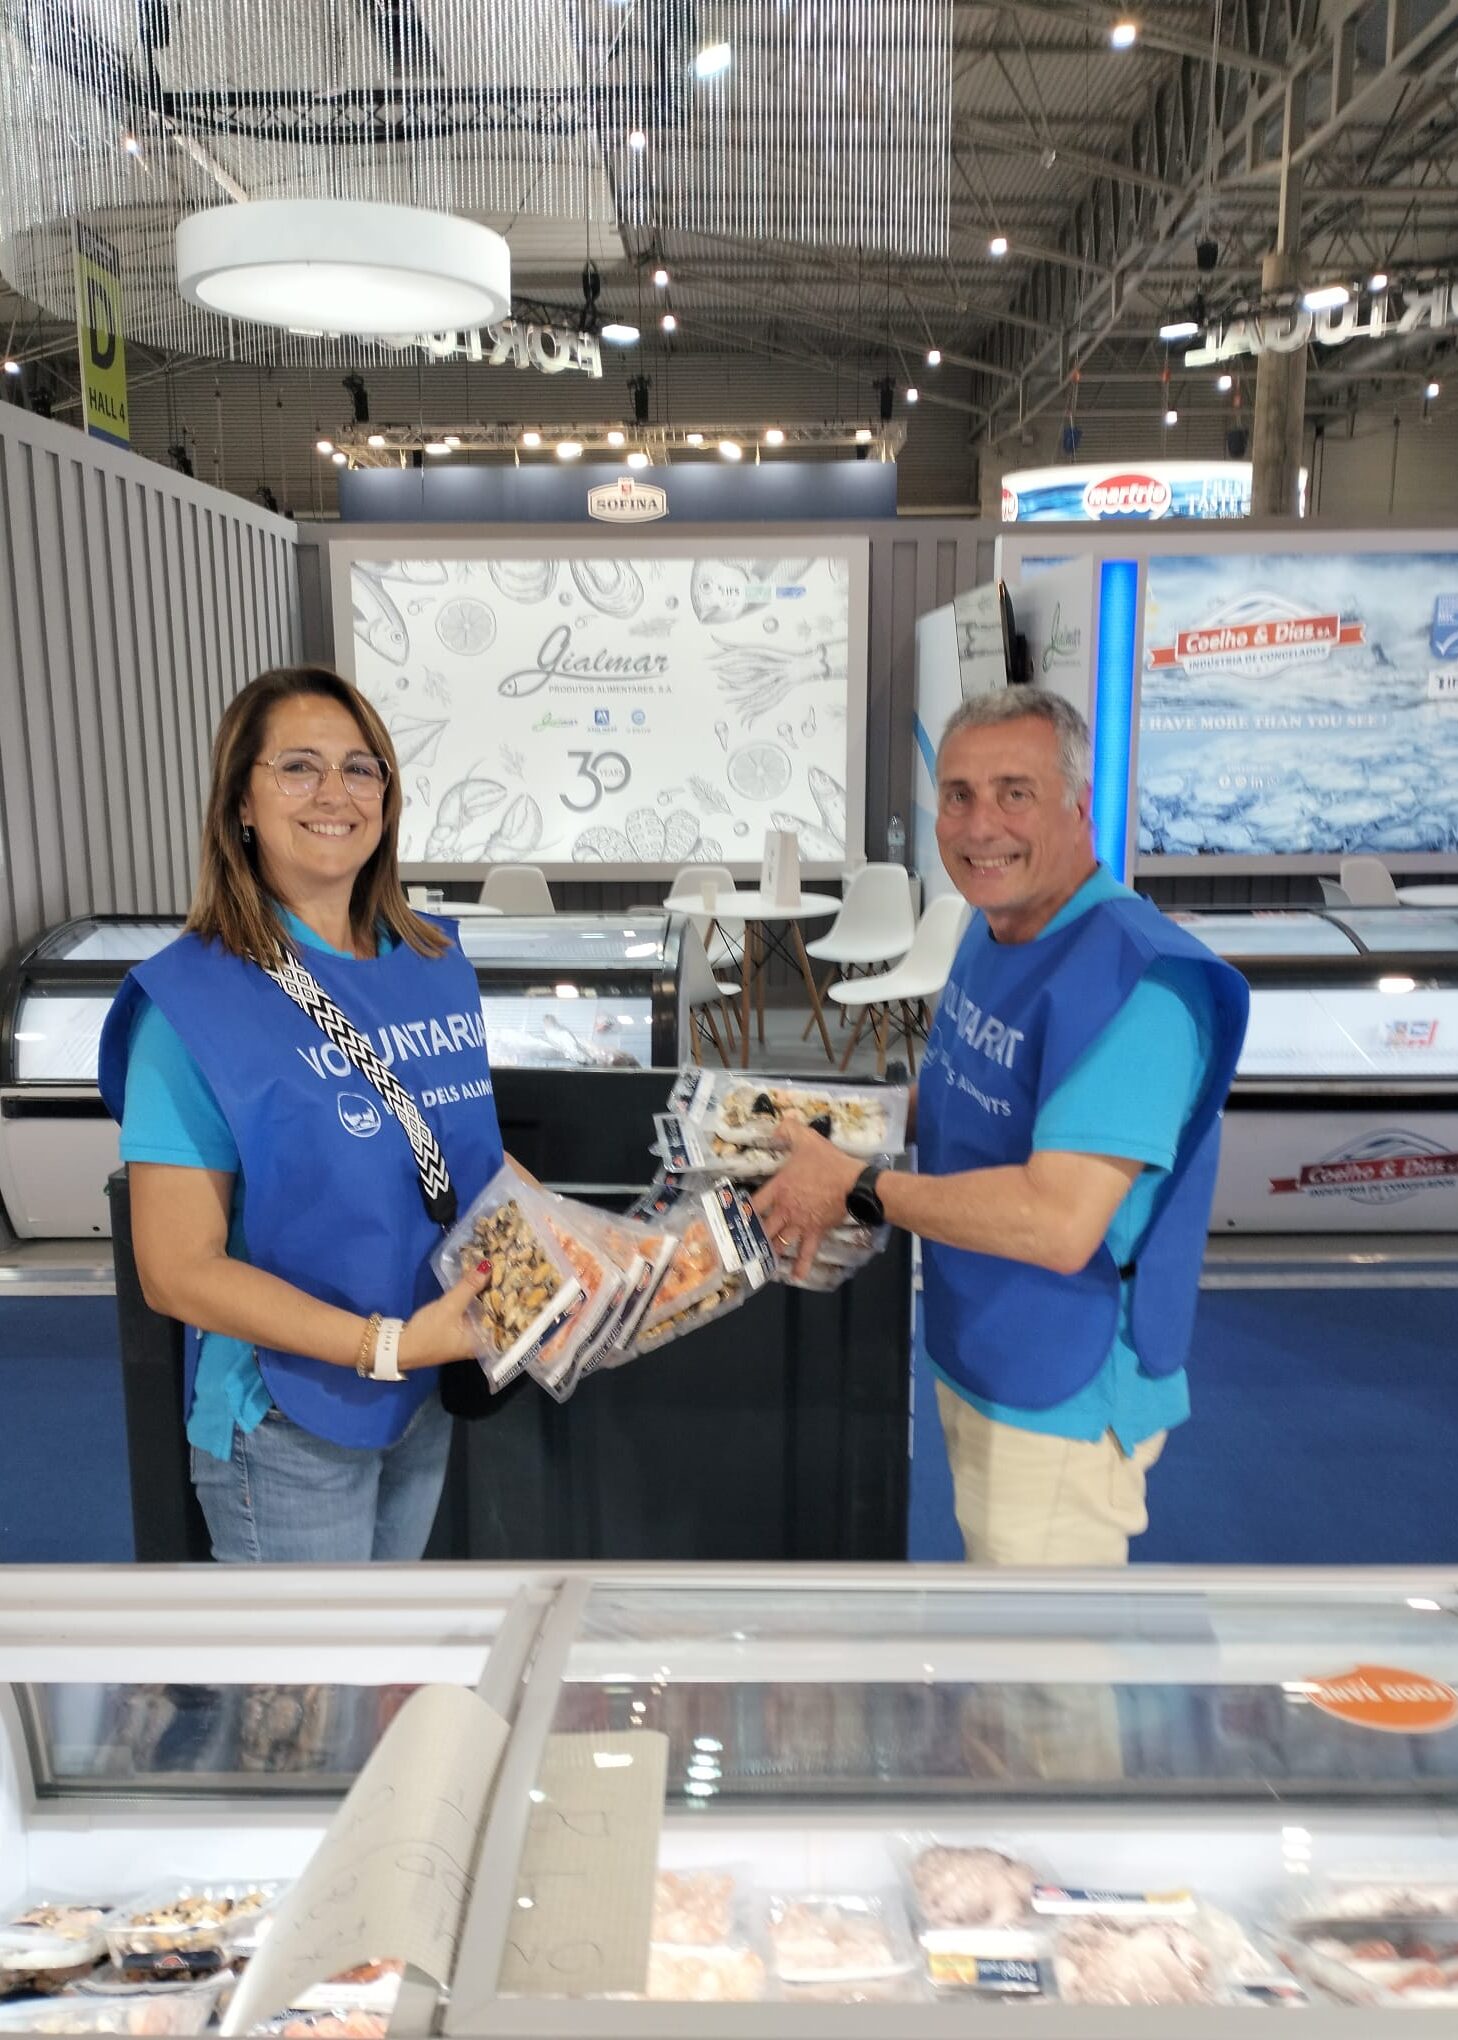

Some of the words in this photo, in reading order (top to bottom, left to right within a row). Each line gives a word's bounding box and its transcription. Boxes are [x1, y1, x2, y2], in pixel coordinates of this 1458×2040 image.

[89, 387, 117, 420] HALL
[119, 403, 126, 424] 4
[596, 499, 659, 512] SOFINA
[1186, 628, 1248, 654] Coelho
[1253, 624, 1268, 645] &
[549, 685, 595, 694] PRODUTOS
[1149, 715, 1195, 730] HAVE
[1201, 715, 1249, 730] MORE
[1254, 714, 1301, 729] THAN
[1308, 714, 1342, 729] YOU
[559, 751, 632, 813] 30
[599, 767, 624, 777] YEARS
[297, 1011, 487, 1079] VOUNTARIA
[421, 1084, 460, 1108] DELS
